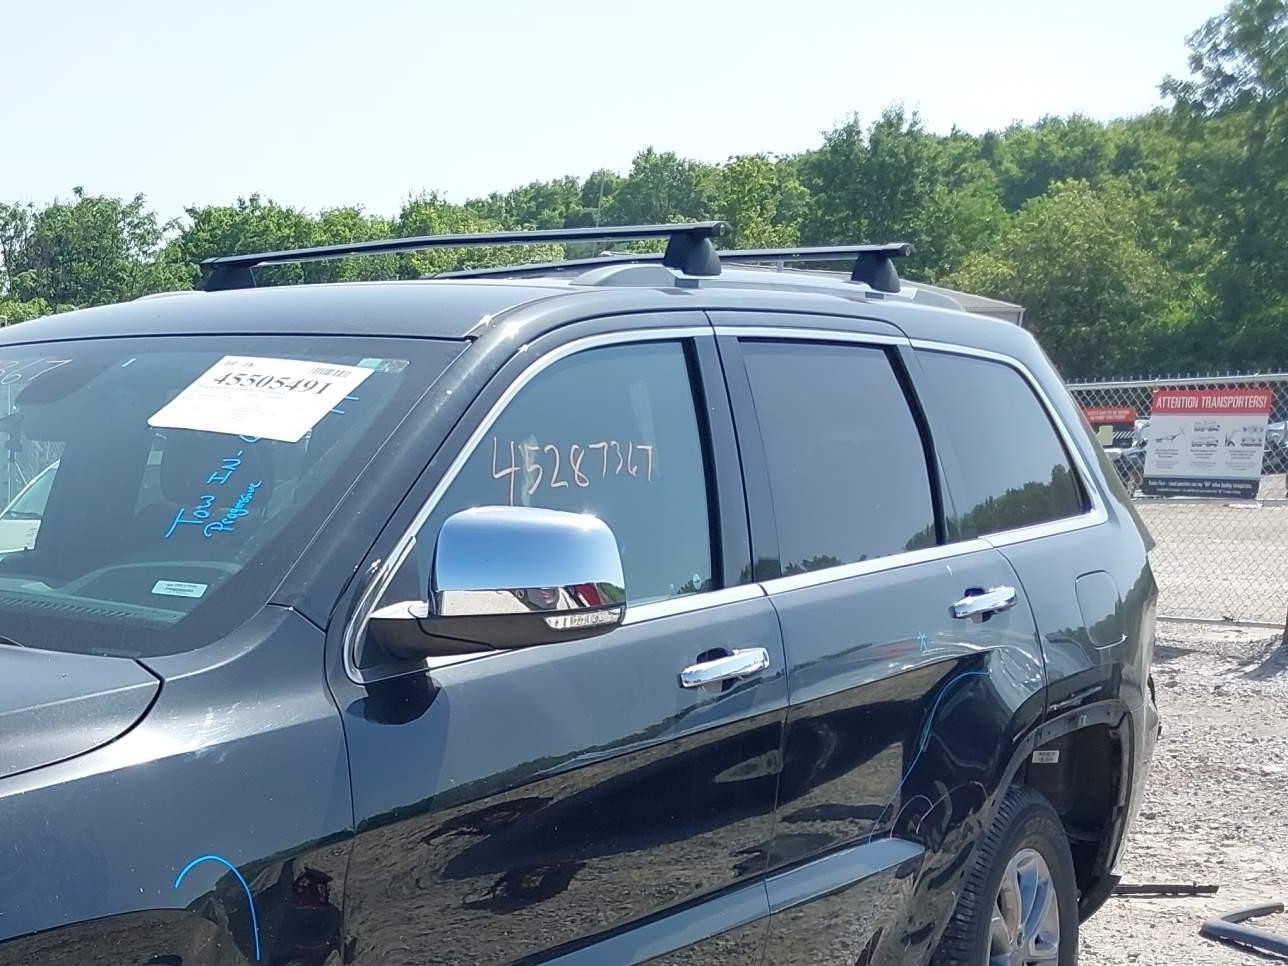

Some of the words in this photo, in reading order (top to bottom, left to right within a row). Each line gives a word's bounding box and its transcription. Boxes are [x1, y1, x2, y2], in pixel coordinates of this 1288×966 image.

[214, 372, 333, 395] 45505491
[1156, 396, 1199, 408] ATTENTION
[1201, 395, 1267, 408] TRANSPORTERS!
[493, 436, 653, 506] 45287367
